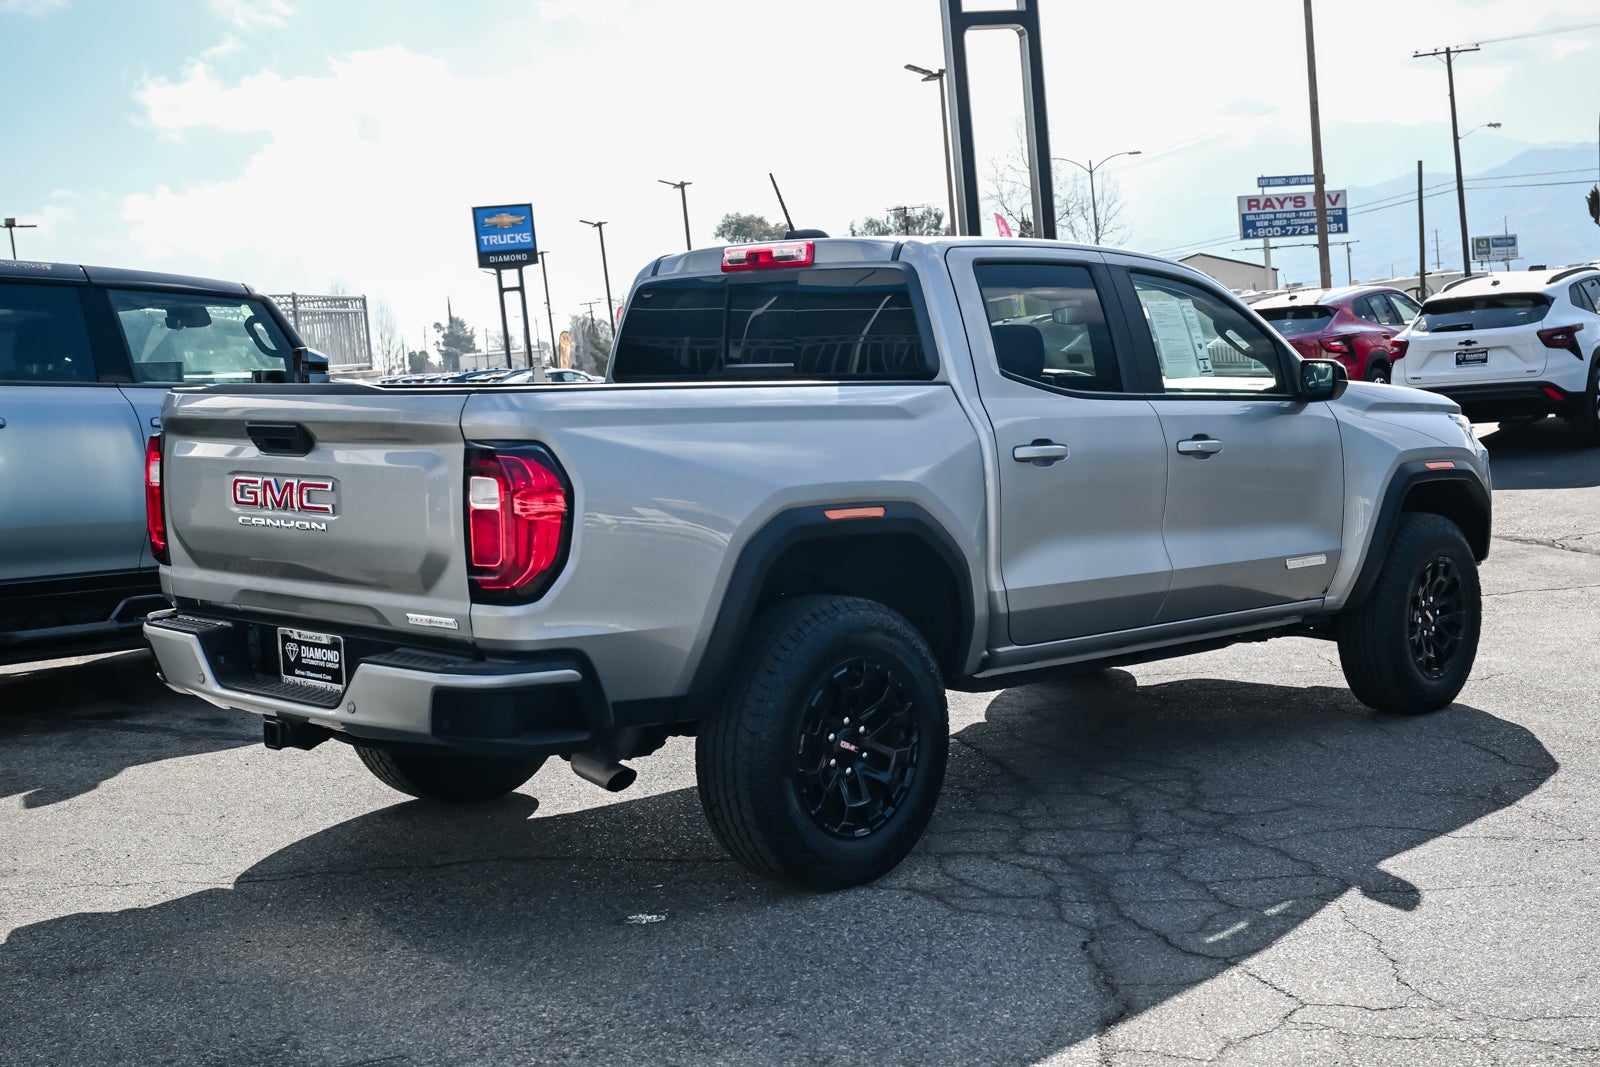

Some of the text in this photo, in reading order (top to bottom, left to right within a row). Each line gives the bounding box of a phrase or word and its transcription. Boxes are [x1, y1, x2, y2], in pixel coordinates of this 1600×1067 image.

[1247, 193, 1340, 211] RAY'S V
[1247, 224, 1343, 237] 1-800-773-81
[481, 232, 532, 246] TRUCKS
[489, 253, 528, 263] DIAMOND
[232, 476, 334, 513] GMC
[238, 516, 328, 532] CANYON
[302, 633, 322, 641] DIAMOND
[301, 646, 339, 662] DIAMOND
[302, 658, 325, 667] AUTOMOTIVE
